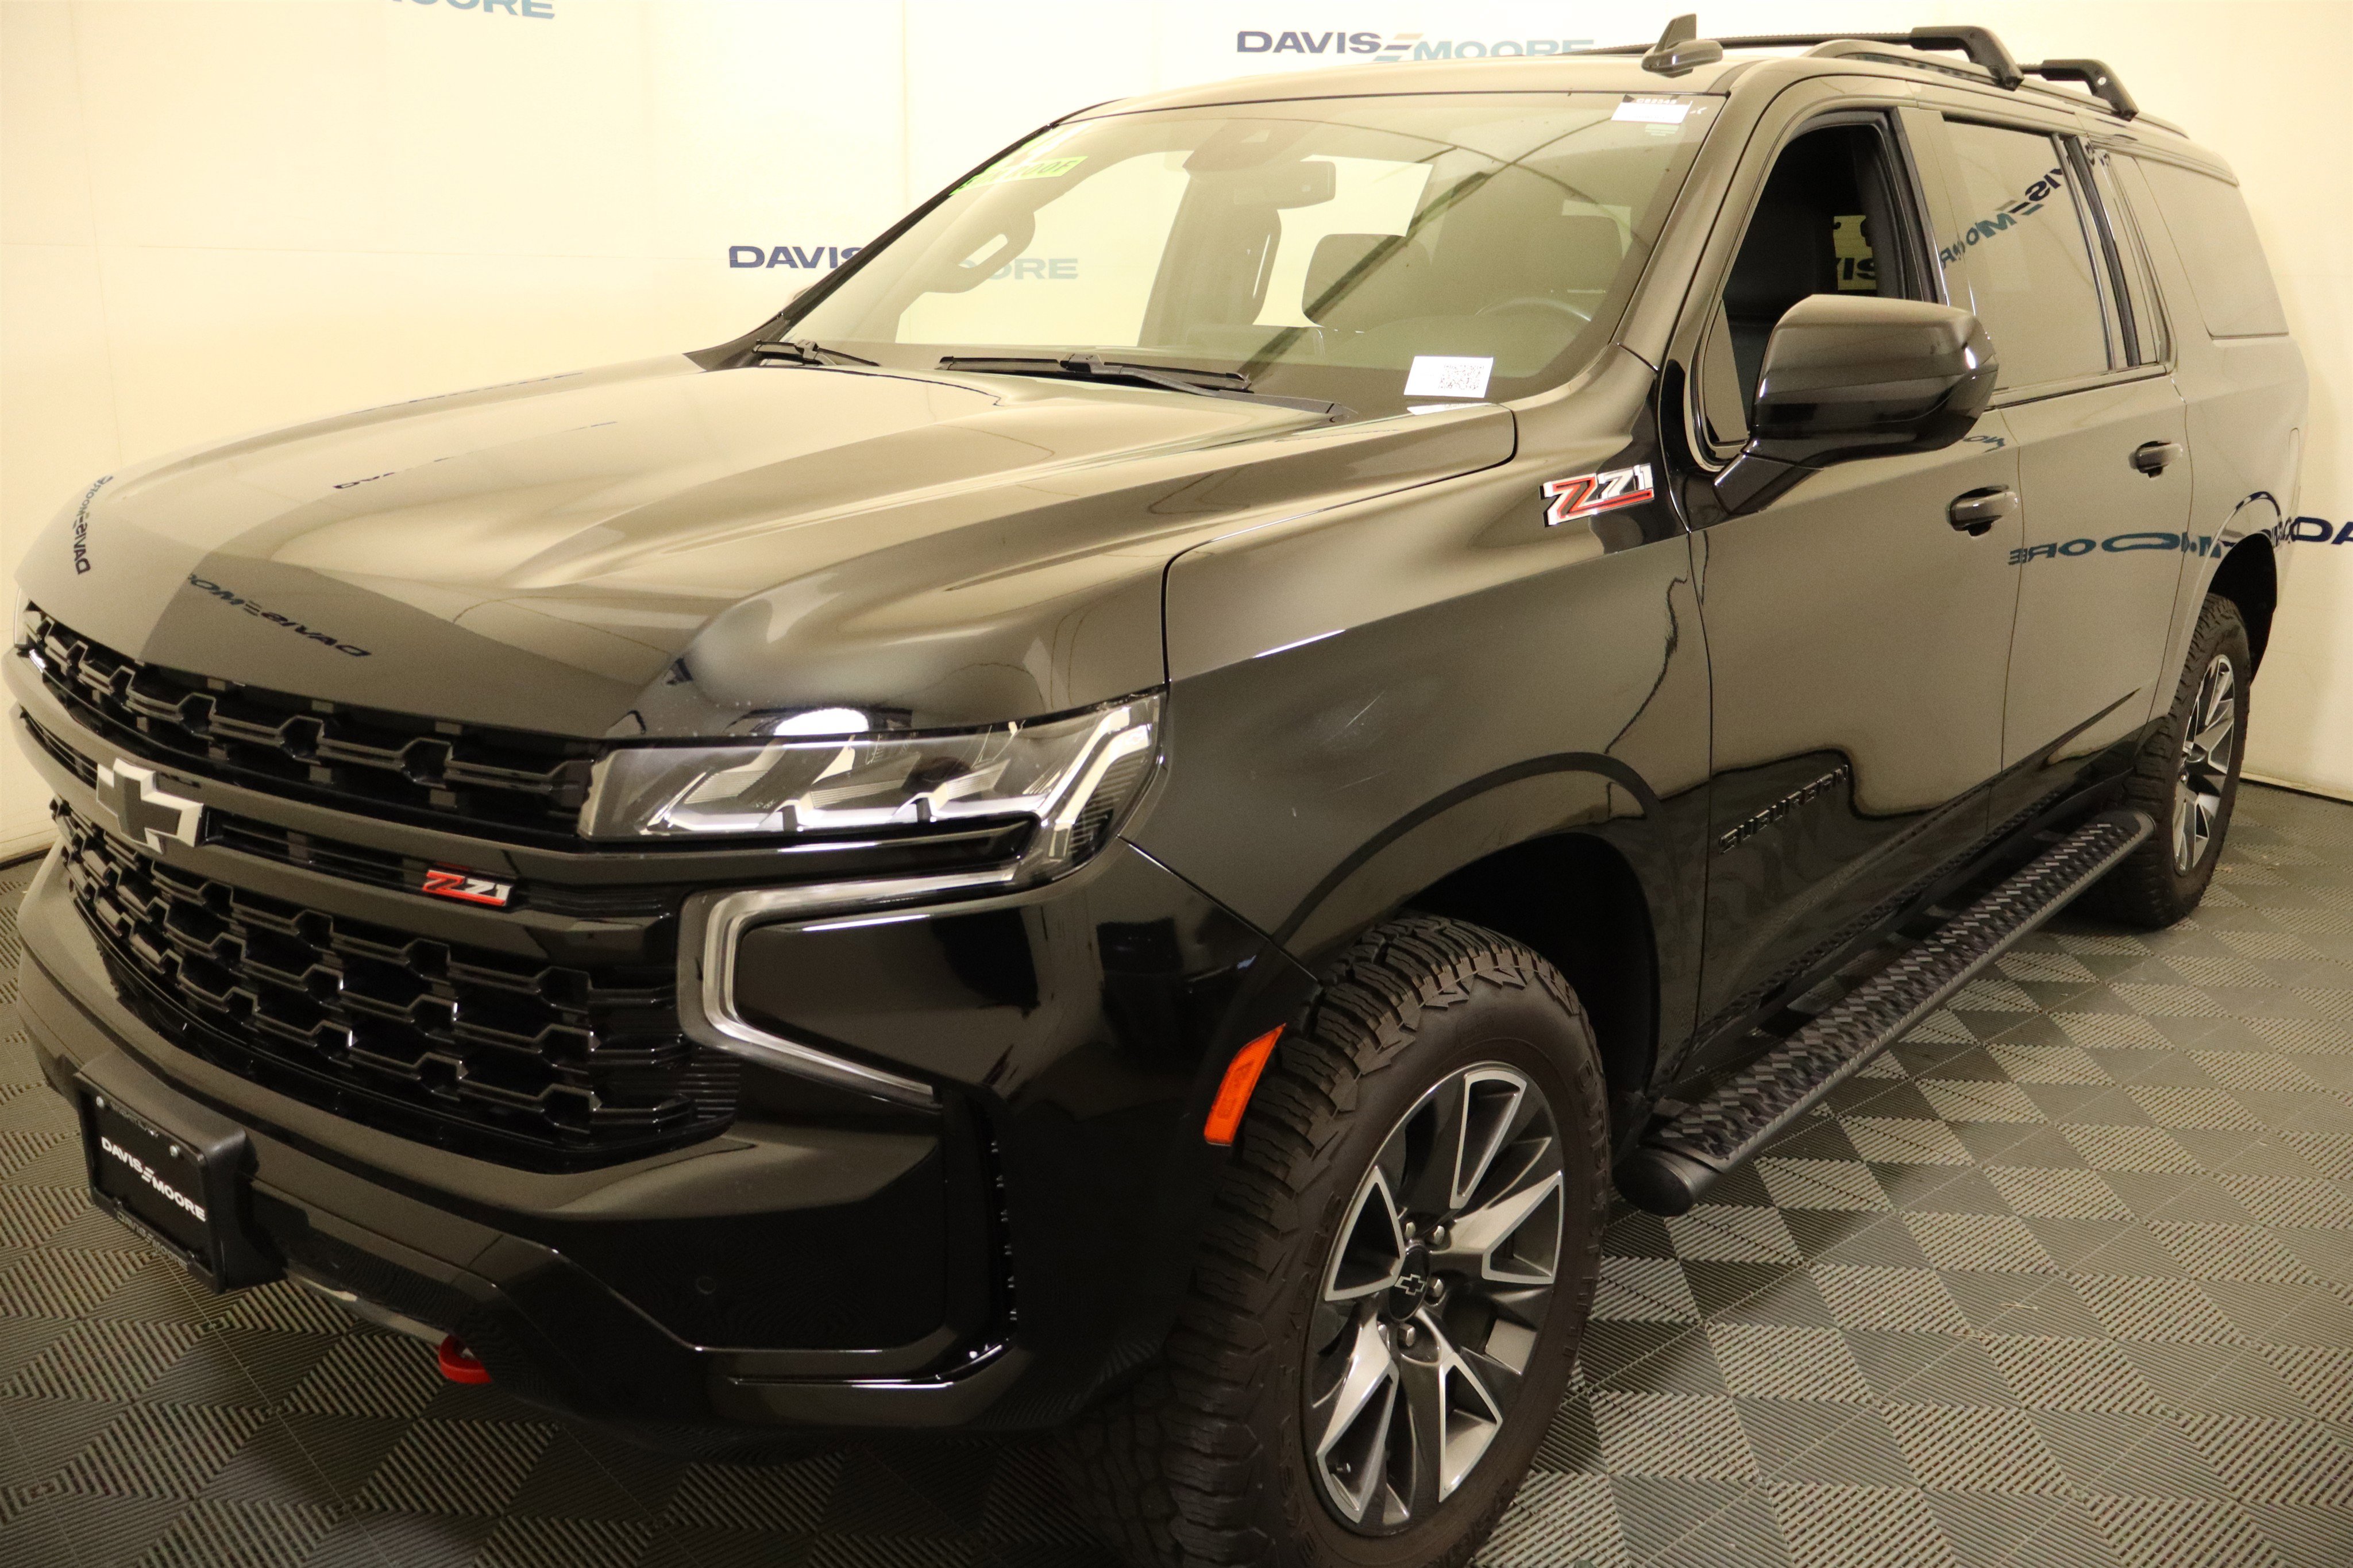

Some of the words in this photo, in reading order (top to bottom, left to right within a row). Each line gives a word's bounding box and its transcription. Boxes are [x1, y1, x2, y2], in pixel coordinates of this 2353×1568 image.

[1236, 31, 1382, 54] DAVIS
[1541, 463, 1654, 526] Z71
[422, 869, 512, 907] Z71
[101, 1136, 143, 1173] DAVIS
[152, 1177, 206, 1222] MOORE
